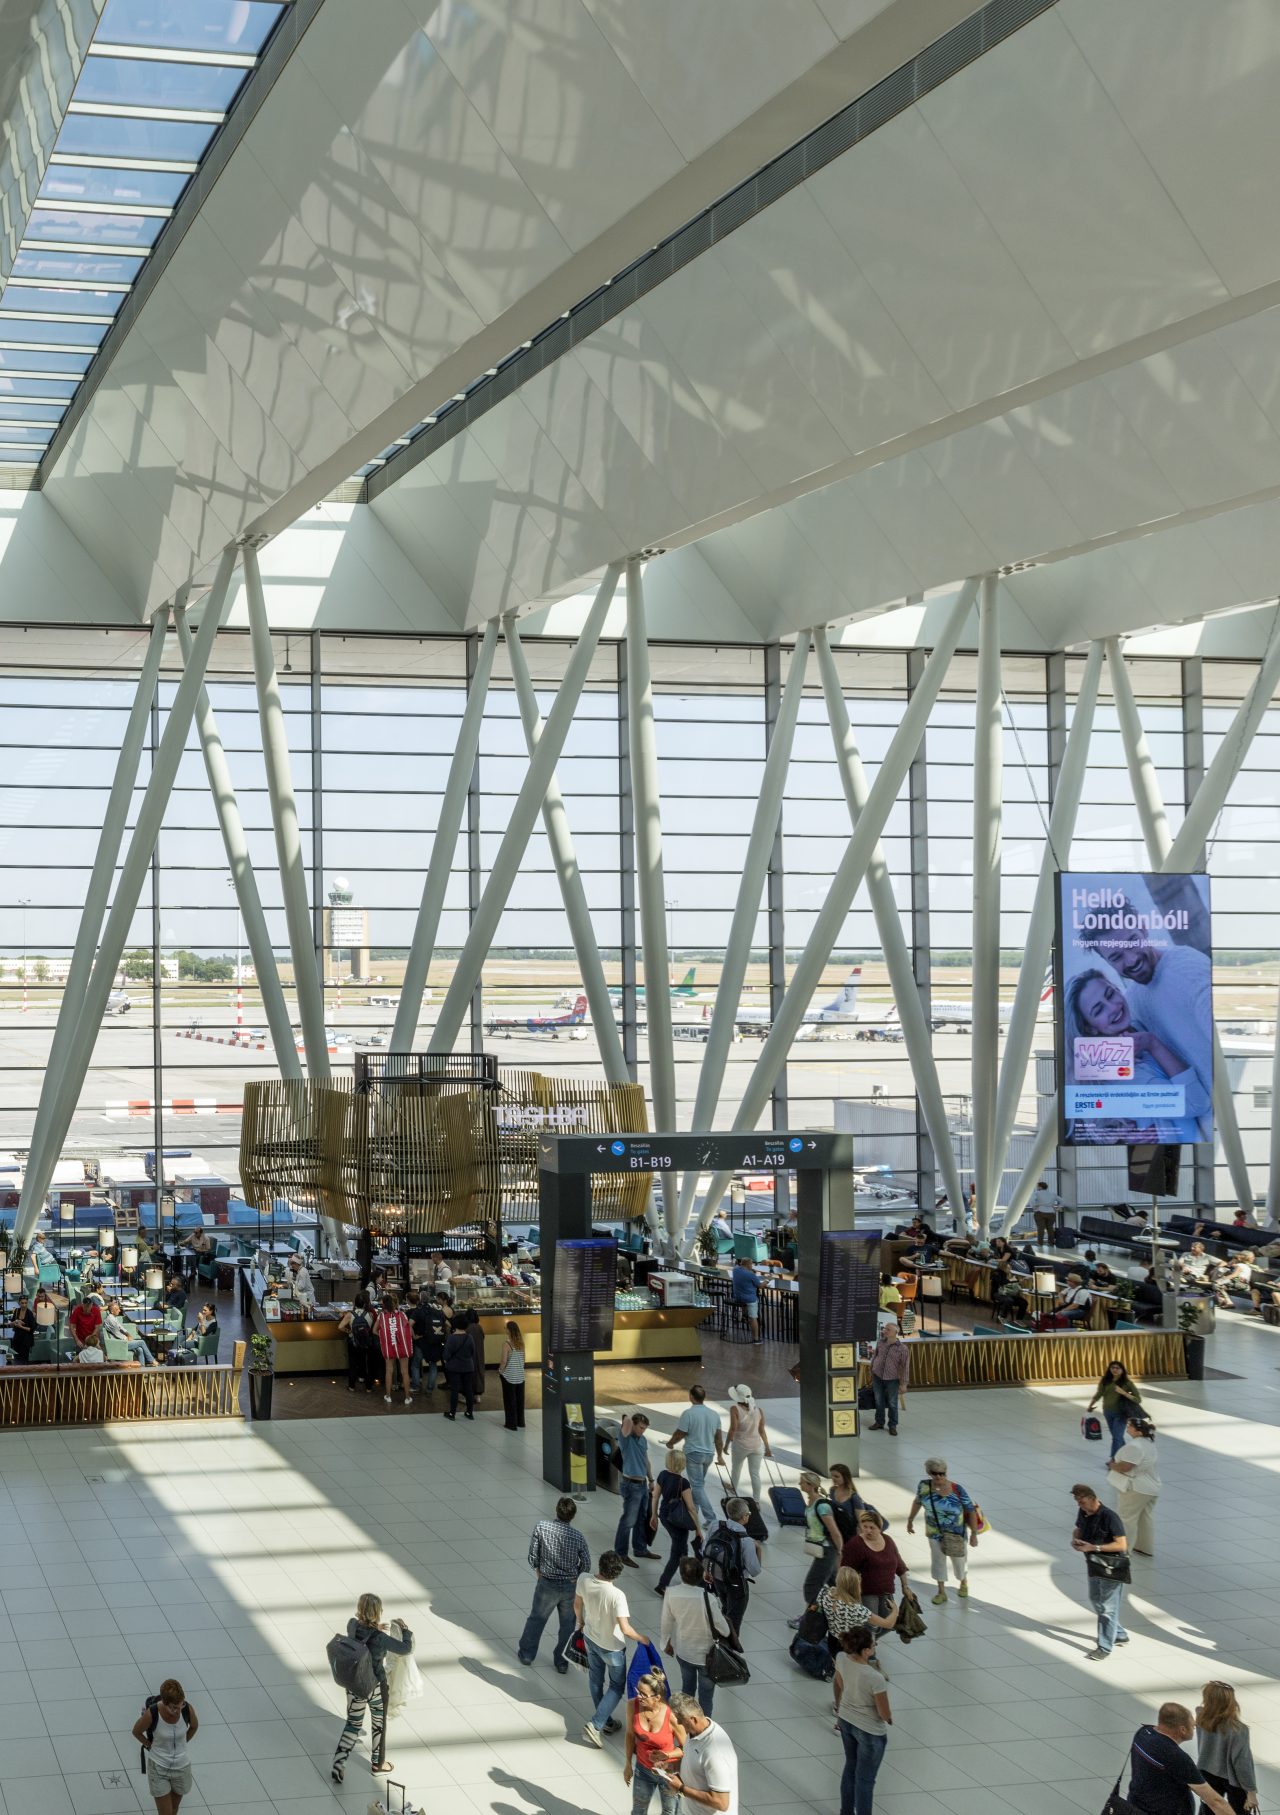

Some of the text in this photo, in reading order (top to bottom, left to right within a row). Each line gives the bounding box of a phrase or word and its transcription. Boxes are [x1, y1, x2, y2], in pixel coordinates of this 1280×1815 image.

[1072, 888, 1125, 908] Helló
[1072, 909, 1189, 930] Londonból!
[1072, 939, 1098, 948] Ingyen
[1099, 938, 1140, 948] repjeggyel
[1074, 1101, 1095, 1109] ERSTE
[630, 1156, 672, 1168] B1-B19
[742, 1154, 785, 1166] A1-A19
